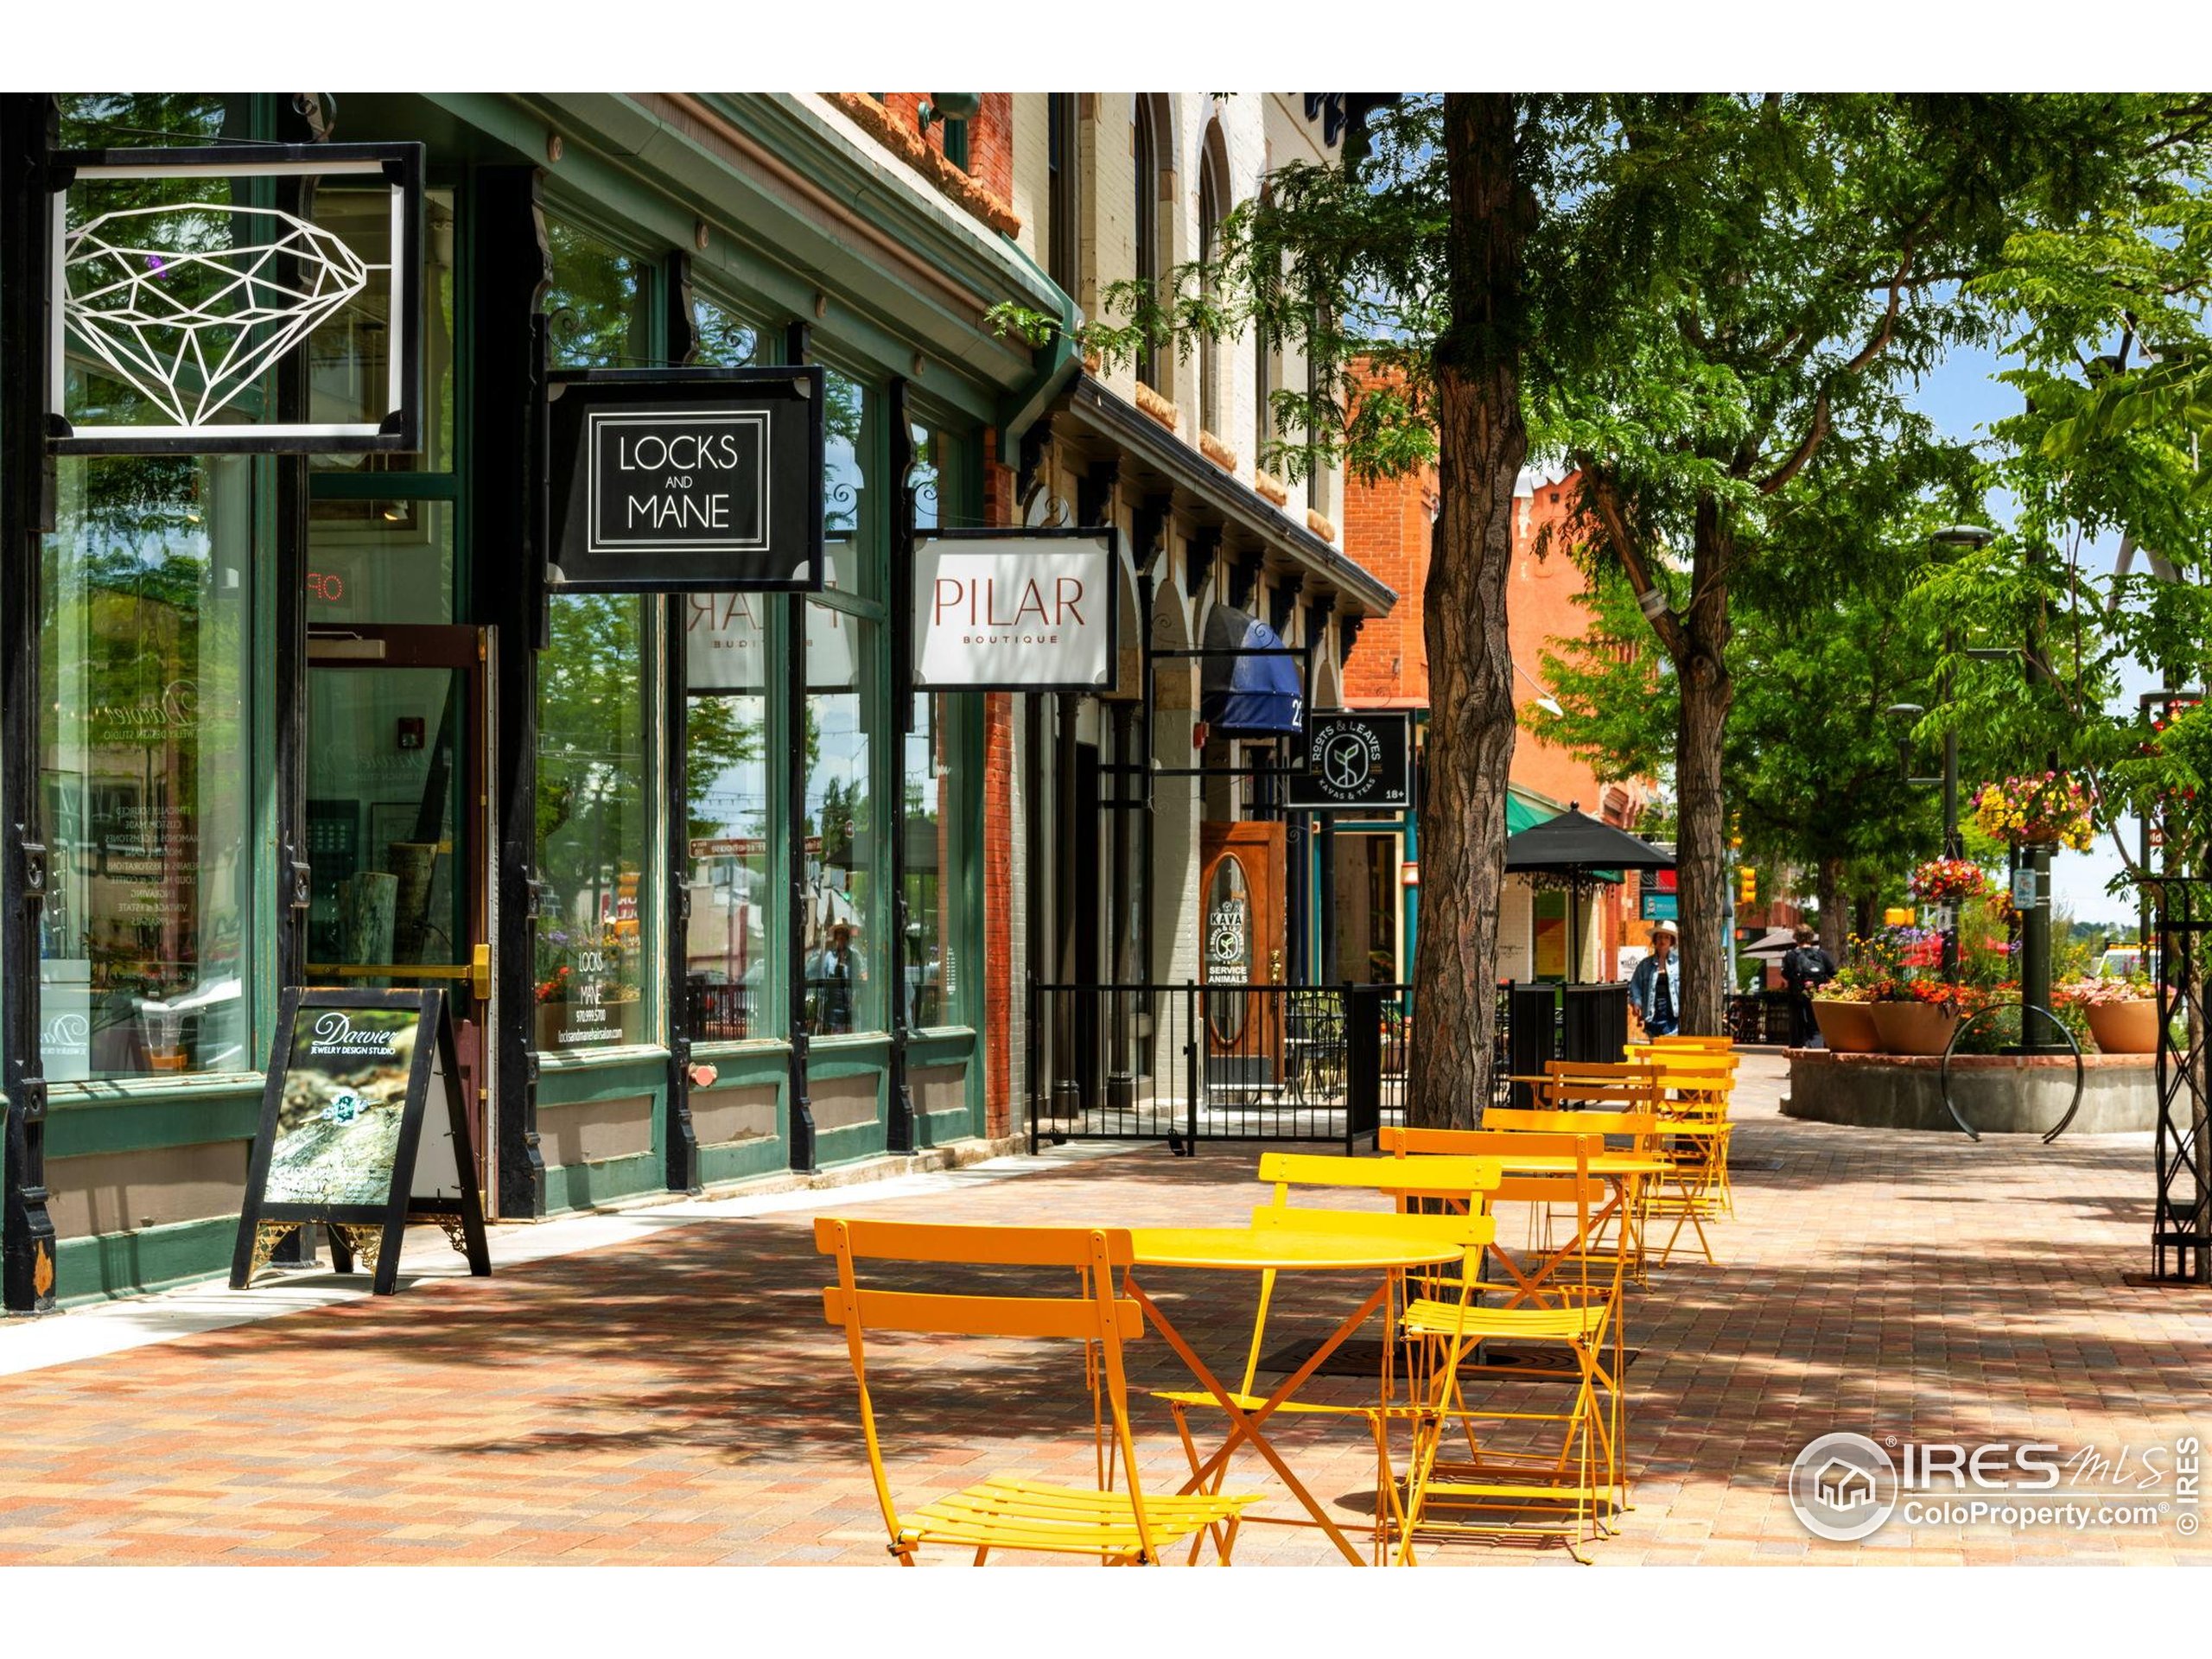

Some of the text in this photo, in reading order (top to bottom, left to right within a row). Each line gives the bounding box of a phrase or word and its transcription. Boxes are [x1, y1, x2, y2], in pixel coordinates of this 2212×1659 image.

[620, 435, 738, 471] LOCKS
[665, 476, 692, 488] AND
[628, 493, 729, 529] MANE
[935, 576, 1084, 626] PILAR
[963, 635, 1058, 645] BOUTIQUE
[1312, 720, 1382, 761] ROOTS & LEAVES
[1319, 778, 1376, 800] KAVAS & TEAS
[1386, 790, 1404, 799] 18+
[1211, 913, 1243, 925] KAVA
[579, 951, 603, 972] LOCKS
[1210, 966, 1247, 975] SERVICE
[580, 984, 603, 1005] MANE
[311, 1012, 398, 1046] Darvier
[558, 1027, 623, 1044] locksandmanehairsalon.com
[311, 1046, 396, 1055] JEWELRY DESIGN STUDIO
